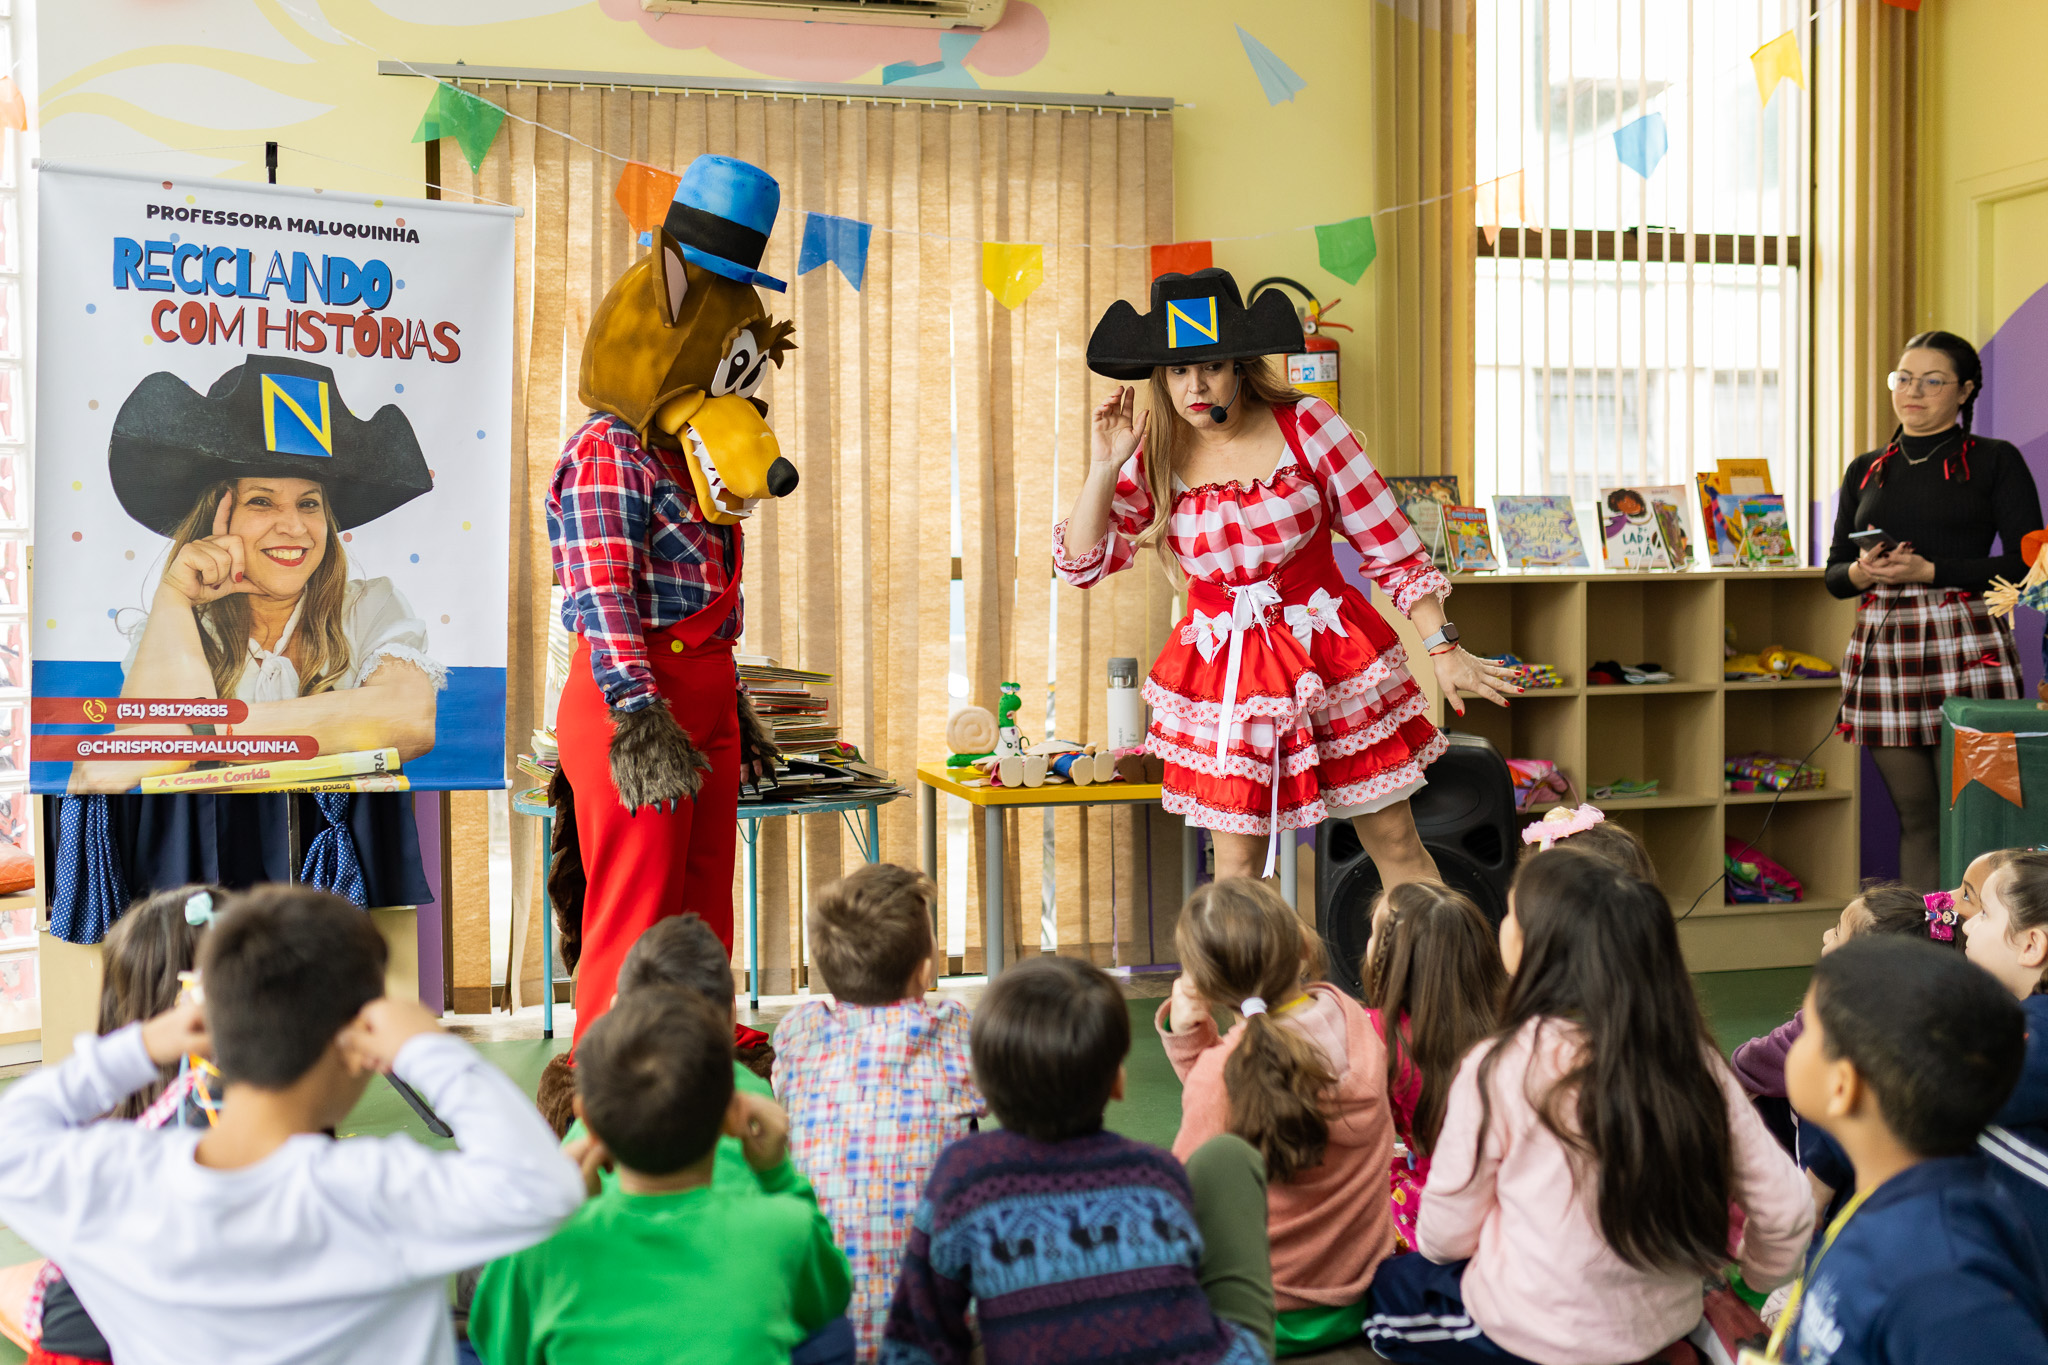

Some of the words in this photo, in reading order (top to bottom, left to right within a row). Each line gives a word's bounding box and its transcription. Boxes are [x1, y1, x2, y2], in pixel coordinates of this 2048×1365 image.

[146, 204, 282, 231] PROFESSORA
[287, 217, 420, 244] MALUQUINHA
[113, 237, 393, 310] RECICLANDO
[151, 299, 246, 347] COM
[258, 308, 462, 364] HISTÓRIAS
[1167, 296, 1219, 348] N
[260, 373, 333, 457] N
[116, 703, 145, 719] (51)
[149, 703, 228, 718] 981796835
[77, 740, 300, 756] @CHRISPROFEMALUQUINHA
[158, 779, 168, 787] A
[174, 773, 219, 786] Grande
[223, 767, 271, 783] Corrida
[323, 783, 350, 791] Branca
